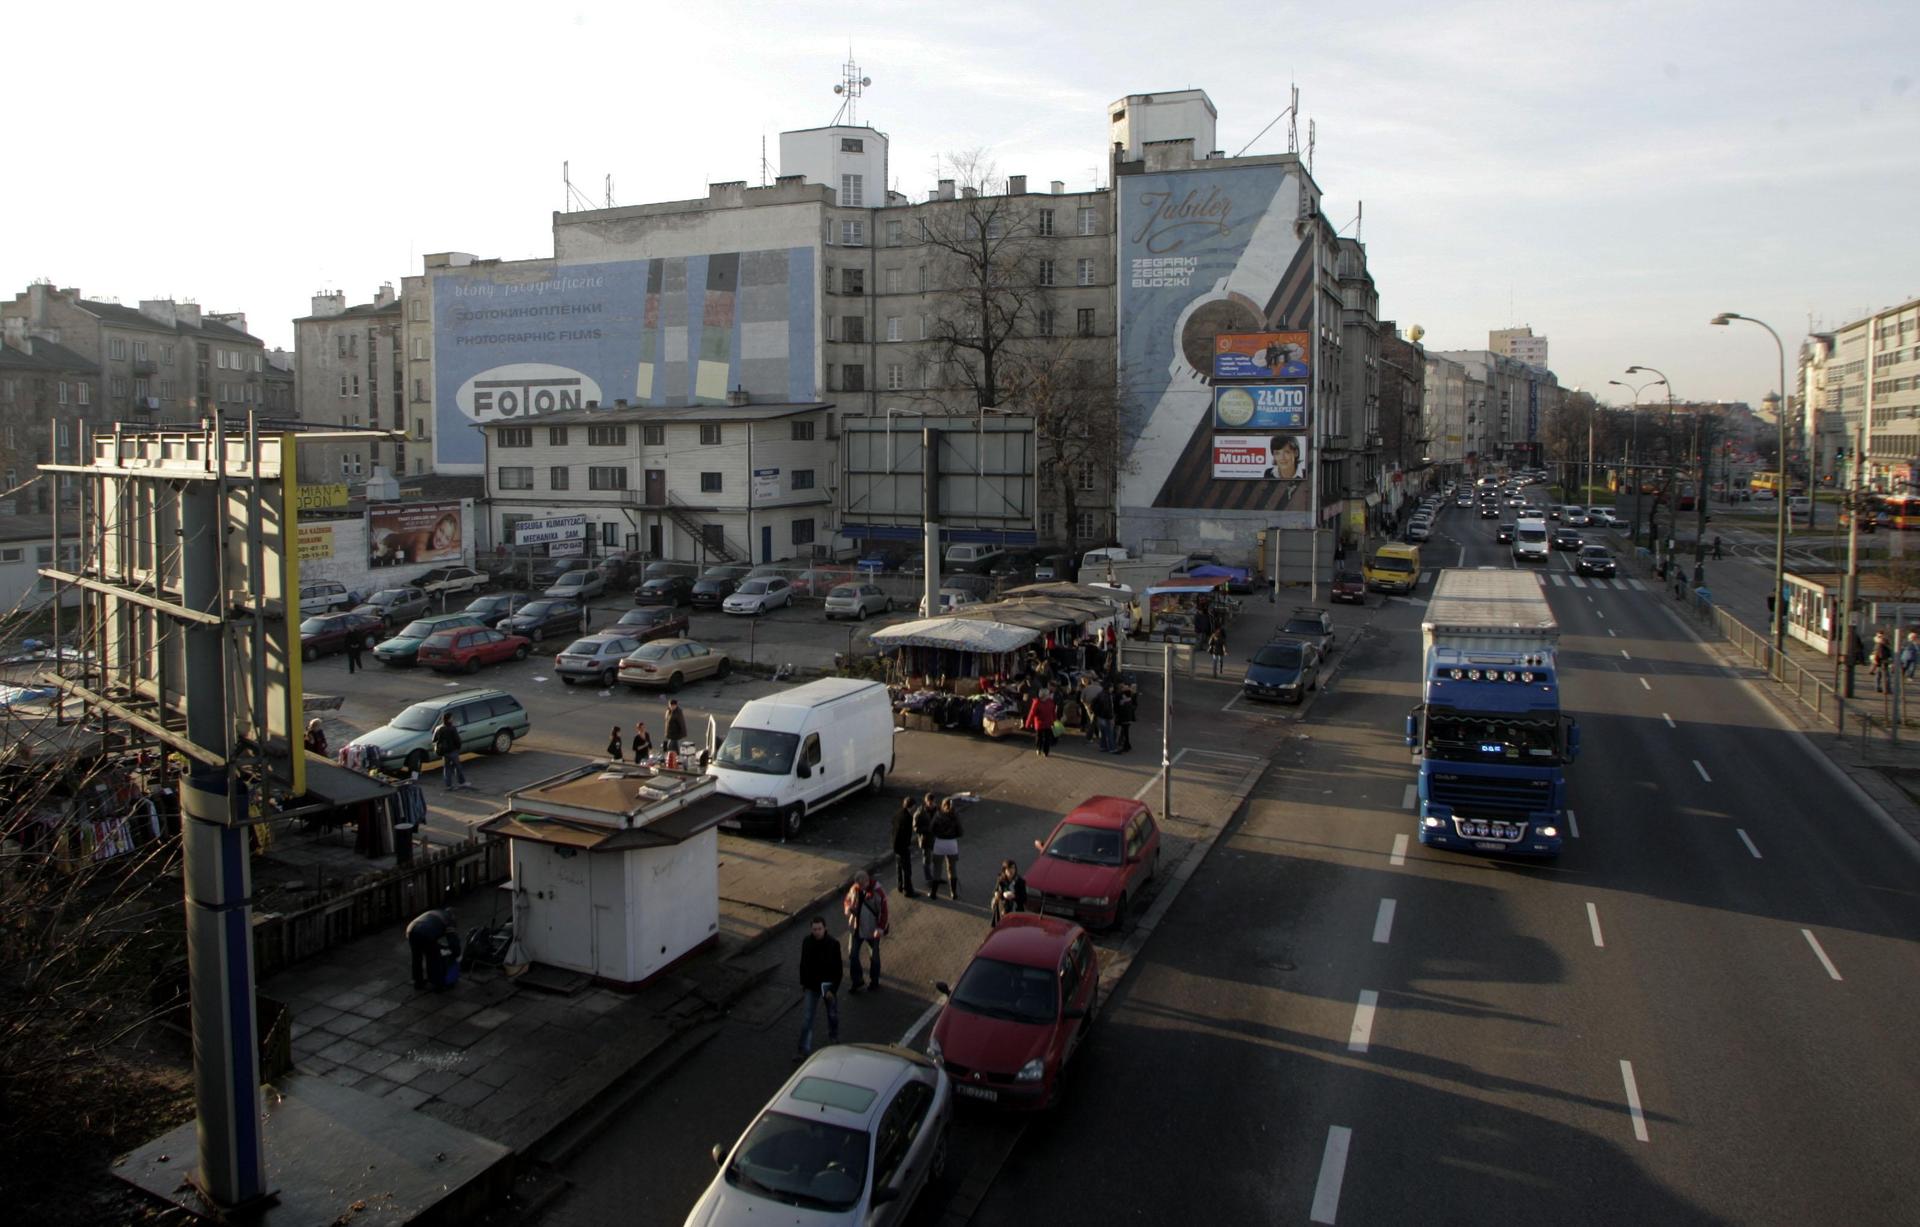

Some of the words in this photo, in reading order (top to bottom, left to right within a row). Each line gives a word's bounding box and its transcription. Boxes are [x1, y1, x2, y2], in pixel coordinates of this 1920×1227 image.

[1132, 257, 1198, 269] ZEGARKI
[1132, 267, 1195, 278] ZEGARY
[1132, 277, 1190, 288] BUDZIKI
[456, 331, 556, 345] PHOTOGRAPHIC
[559, 328, 603, 341] FILMS
[474, 378, 581, 417] FOTON
[1258, 388, 1303, 406] ZŁOTO
[1219, 453, 1265, 464] Munio
[523, 531, 558, 543] MECHANIKA
